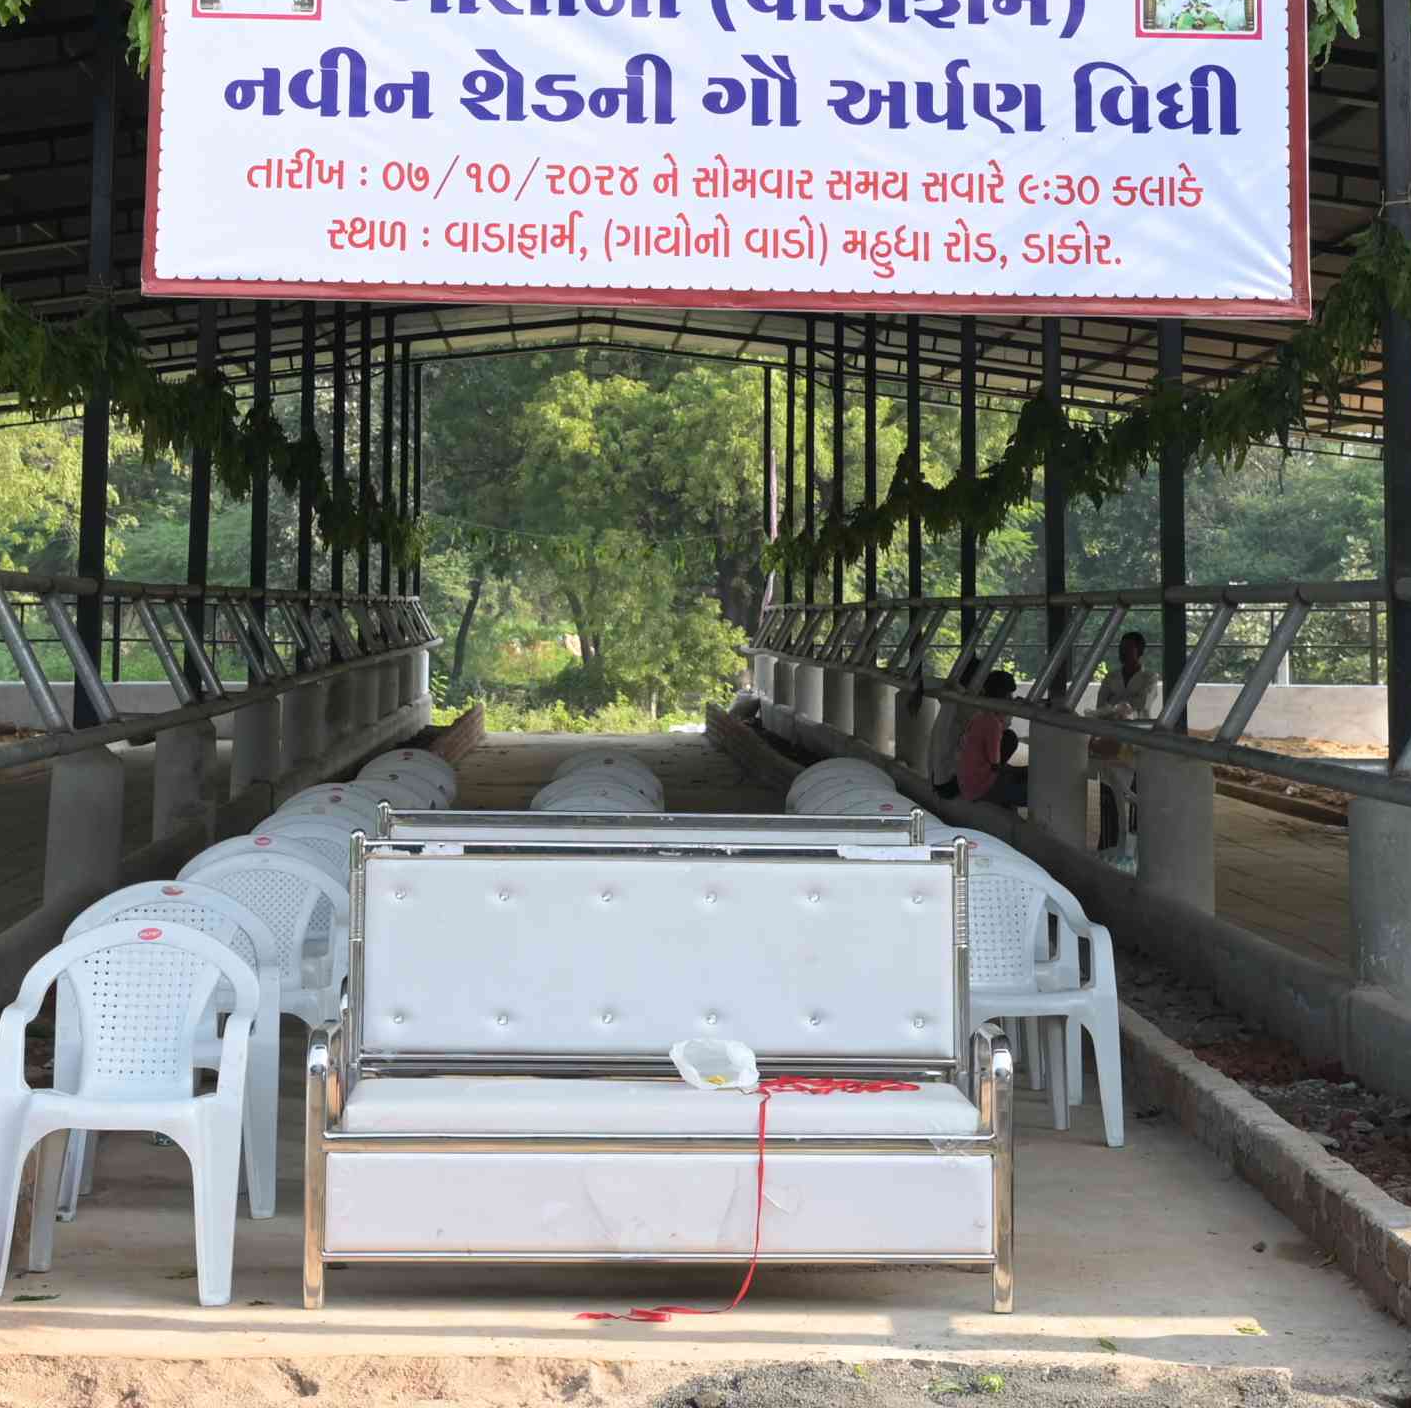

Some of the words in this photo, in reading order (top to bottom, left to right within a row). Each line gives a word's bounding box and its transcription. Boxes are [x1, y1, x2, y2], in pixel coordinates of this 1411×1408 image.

[224, 47, 434, 120] નવીન
[460, 48, 676, 125] શેડની
[702, 53, 801, 128] ગૌ
[828, 57, 1045, 135] અર્પણ
[247, 147, 345, 190] તારીખ
[653, 153, 679, 197] ને
[694, 154, 814, 201] સોમવાર
[827, 169, 909, 202] સમય
[923, 159, 1005, 205] સવારે
[1113, 163, 1203, 208] કલાકે
[327, 217, 407, 252] સ્થળ
[444, 209, 589, 261] વાડાફાર્મ,
[604, 212, 731, 259] (ગાયોનો
[744, 215, 829, 264] વાડો)
[843, 226, 931, 280] મહુધા
[944, 218, 1009, 270] રોડ,
[1021, 220, 1122, 271] ડાકોર.
